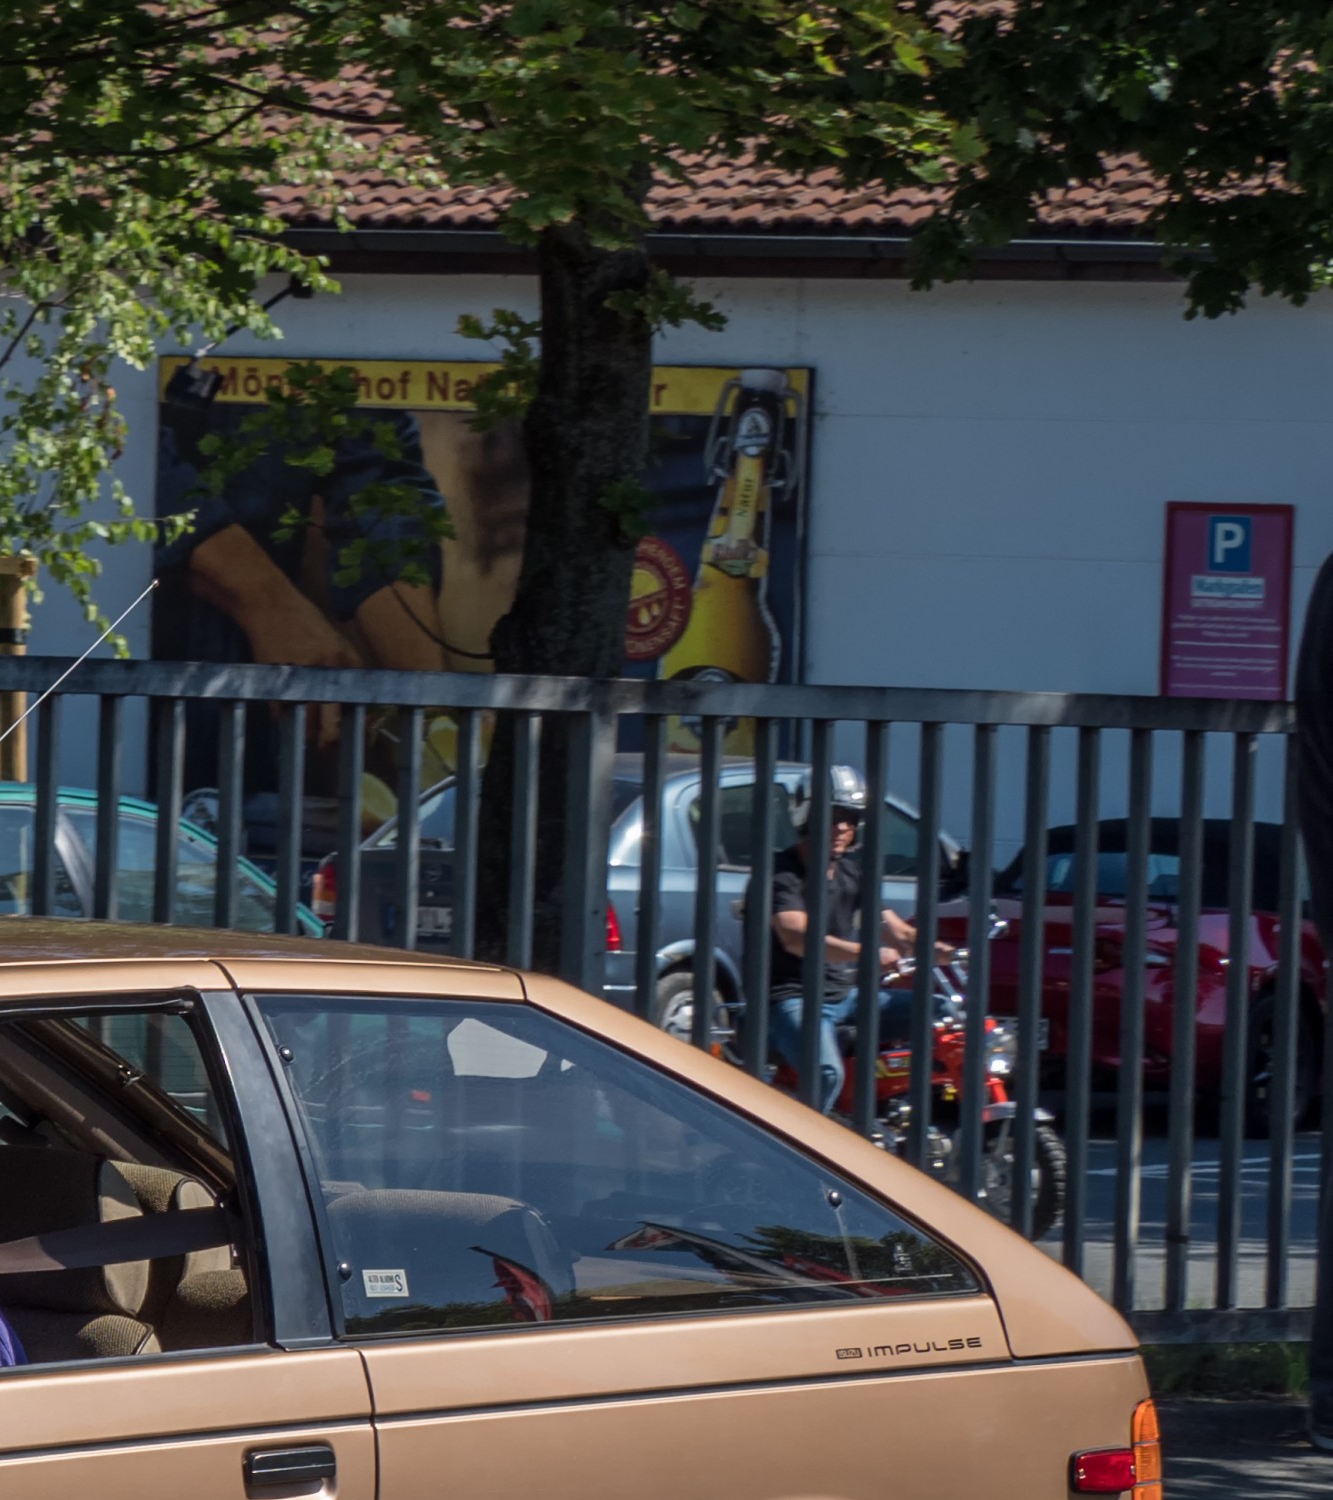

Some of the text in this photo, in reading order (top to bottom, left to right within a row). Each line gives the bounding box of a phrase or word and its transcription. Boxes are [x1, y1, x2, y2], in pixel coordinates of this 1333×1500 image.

[211, 366, 411, 400] Mönhof
[1213, 522, 1245, 563] P
[867, 1337, 983, 1358] IMPULSE
